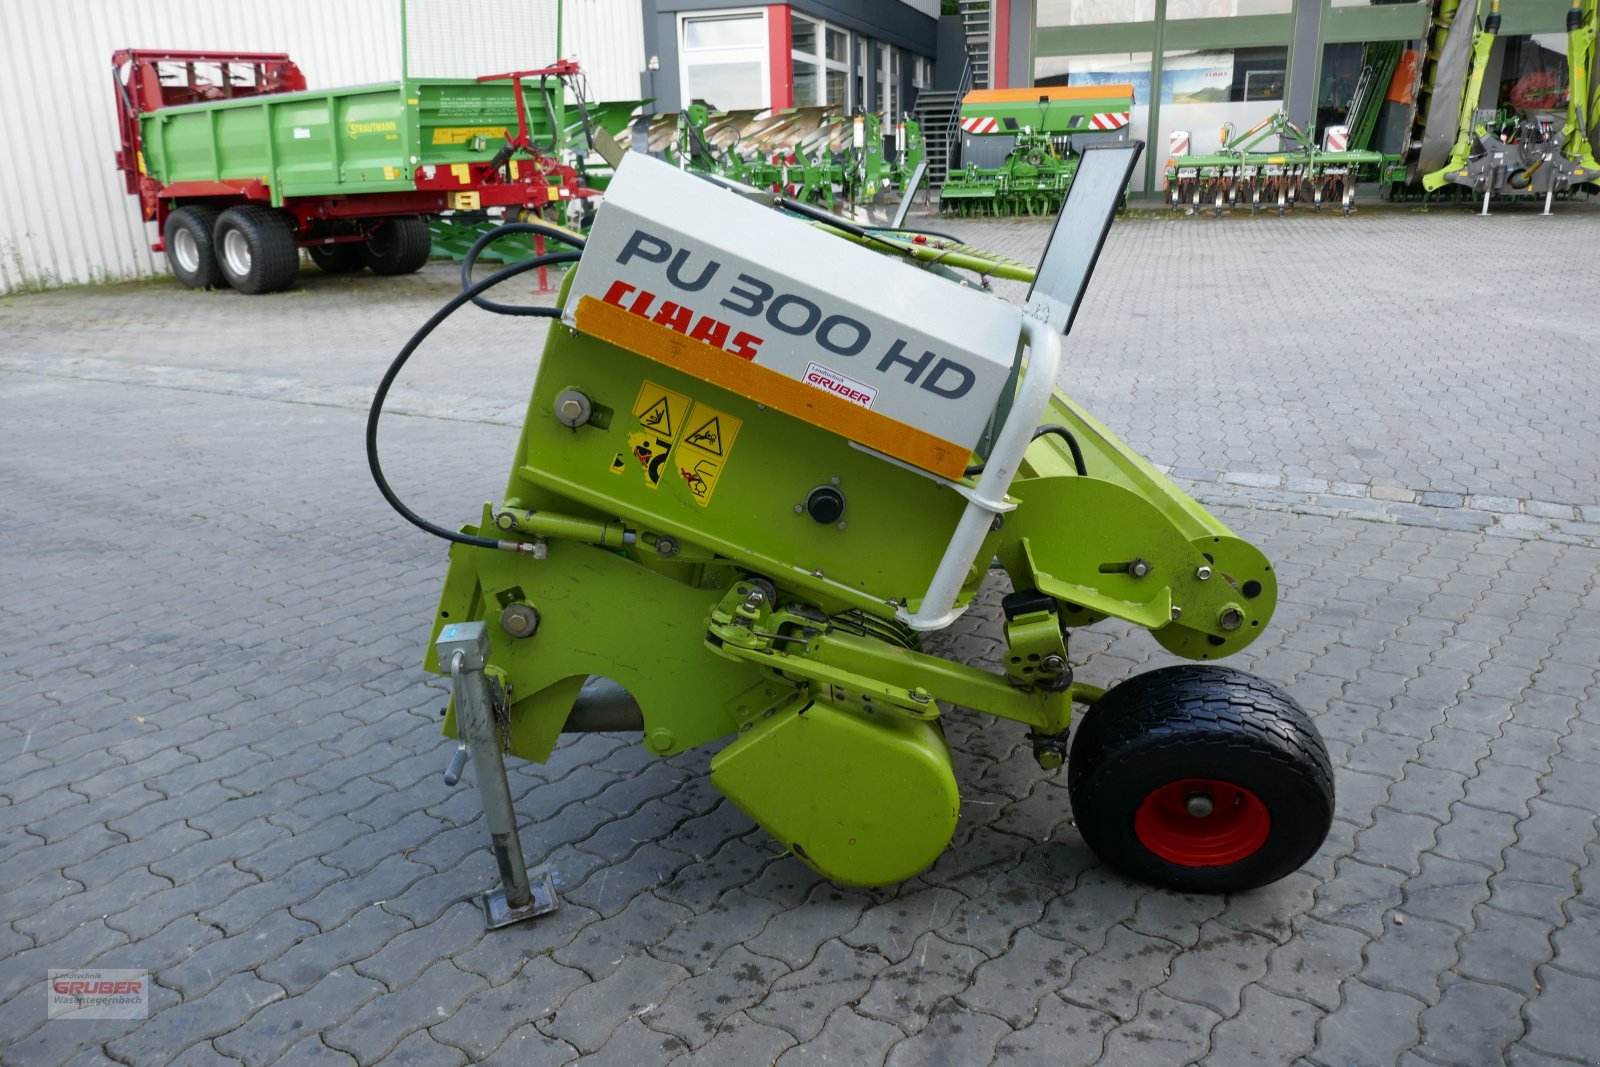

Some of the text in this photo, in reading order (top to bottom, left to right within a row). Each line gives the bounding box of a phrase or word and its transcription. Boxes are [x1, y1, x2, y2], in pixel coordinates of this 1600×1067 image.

[602, 280, 764, 361] CLAAS
[616, 230, 721, 292] PU
[719, 273, 872, 357] 300
[875, 338, 976, 399] HD
[808, 373, 871, 405] GRUBER
